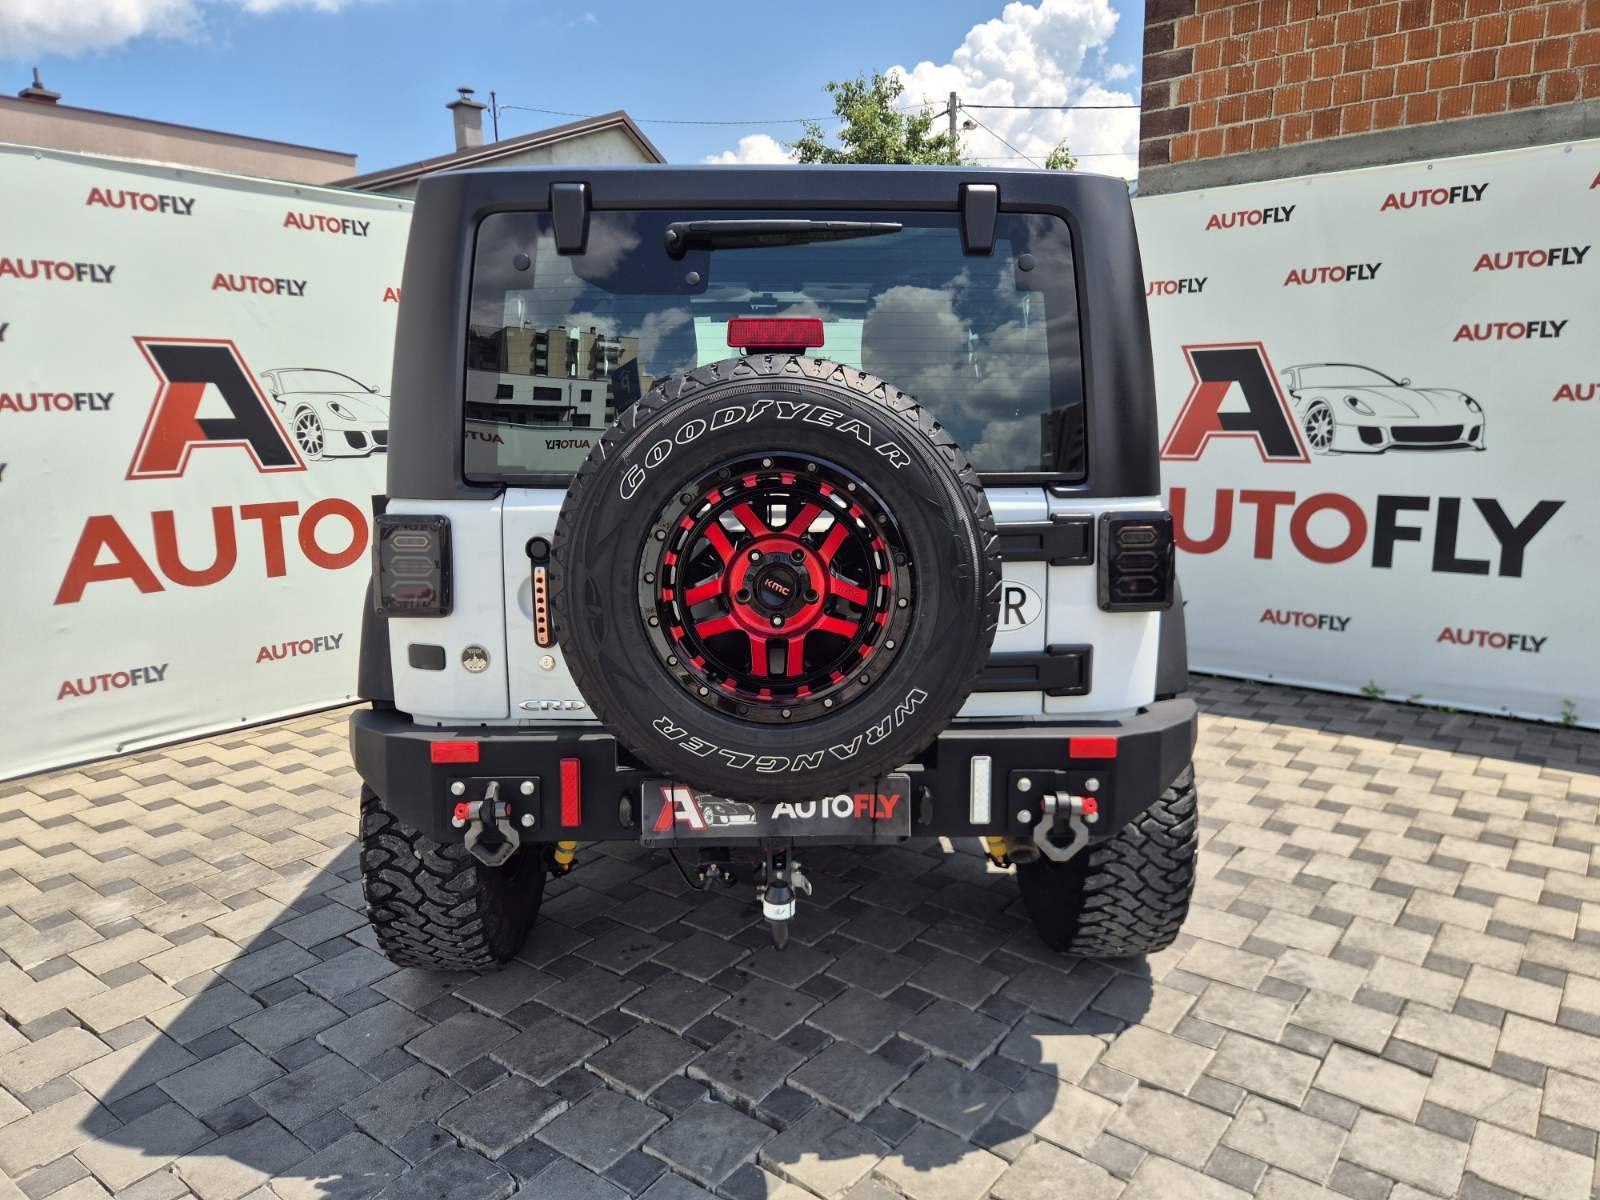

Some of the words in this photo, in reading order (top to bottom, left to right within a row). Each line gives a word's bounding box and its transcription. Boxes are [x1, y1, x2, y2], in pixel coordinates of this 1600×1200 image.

[86, 187, 196, 216] AUTOFLY
[1380, 182, 1490, 212] AUTOFLY
[283, 211, 371, 237] AUTOFLY
[1205, 205, 1296, 231] AUTOFLY
[0, 257, 116, 284] AUTOFLY
[1473, 245, 1591, 272] AUTOFLY
[211, 273, 307, 297] AUTOFLY
[1284, 262, 1382, 287] AUTOFLY
[1453, 319, 1568, 343] AUTOFLY
[0, 392, 114, 412] AUTOFLY
[619, 399, 911, 500] GOODYEAR
[1259, 608, 1352, 632] AUTOFLY
[255, 633, 344, 663] AUTOFLY
[1435, 627, 1548, 653] AUTOFLY
[56, 663, 169, 700] AUTOFLY
[653, 688, 928, 772] WRANGLER
